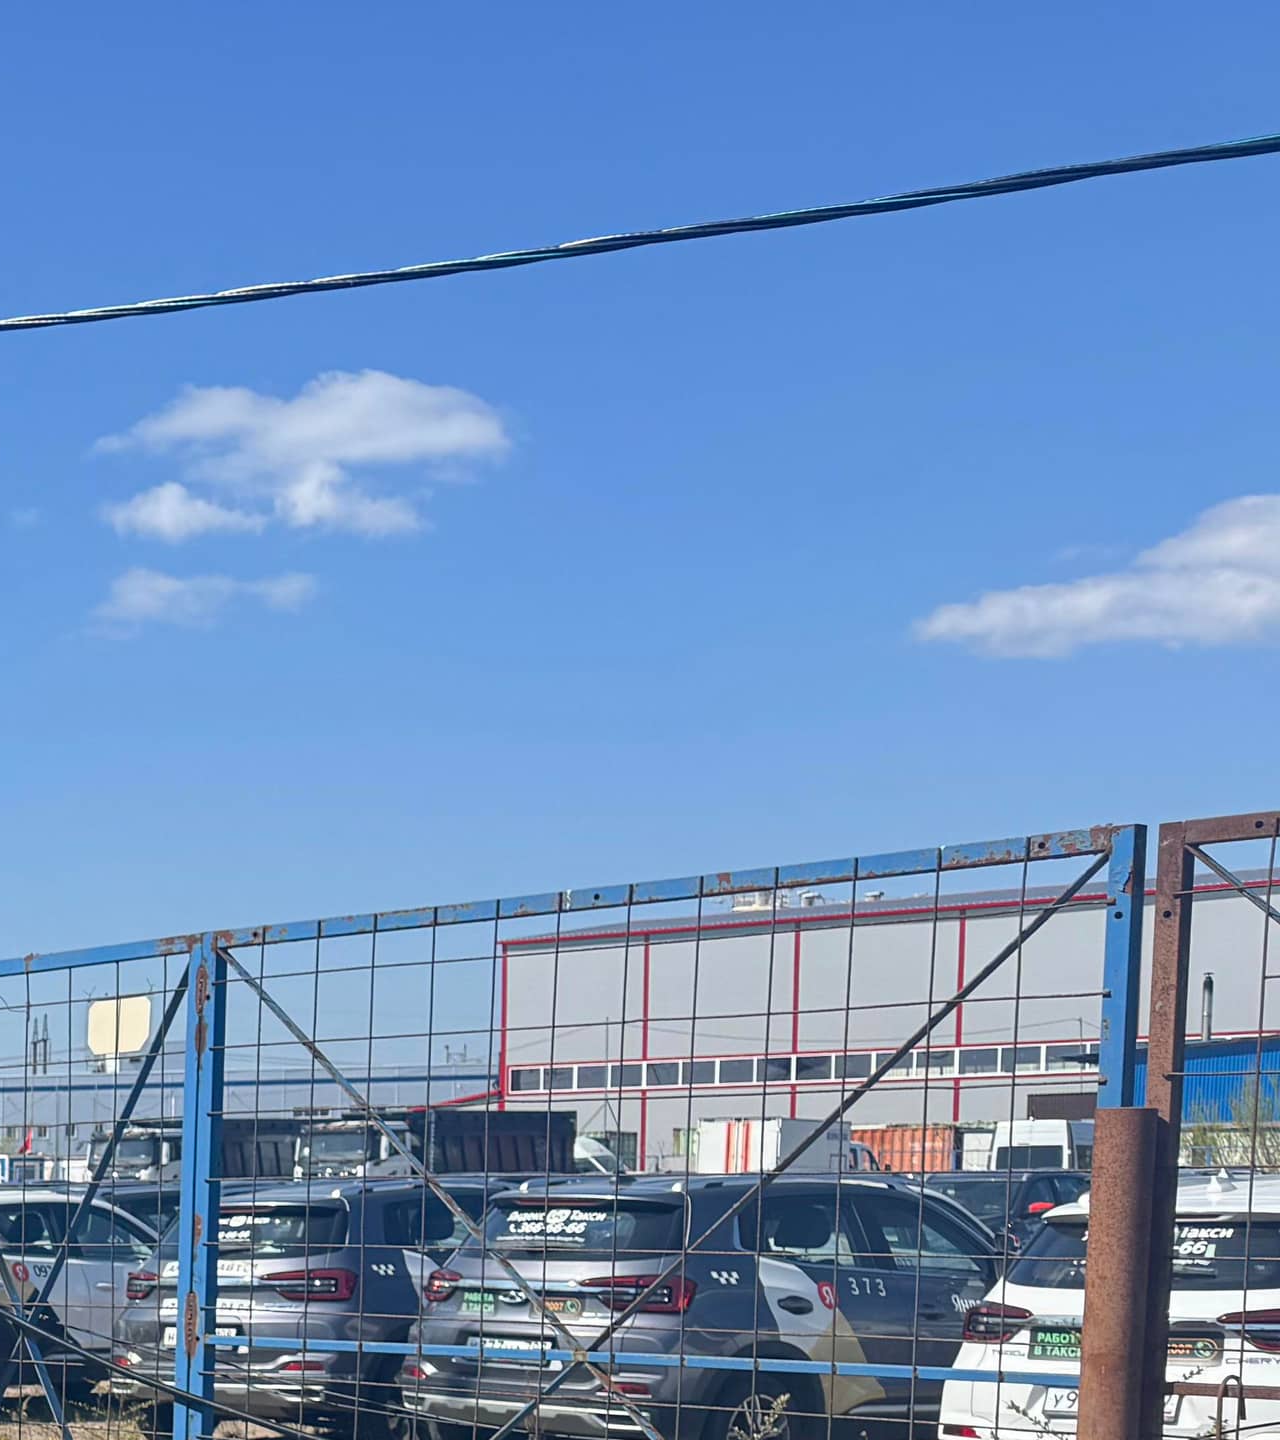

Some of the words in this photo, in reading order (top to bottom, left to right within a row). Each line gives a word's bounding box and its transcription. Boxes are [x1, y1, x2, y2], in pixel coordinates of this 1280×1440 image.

[33, 1264, 52, 1278] 09
[1037, 1332, 1081, 1344] РАБОТ
[1034, 1346, 1042, 1355] В
